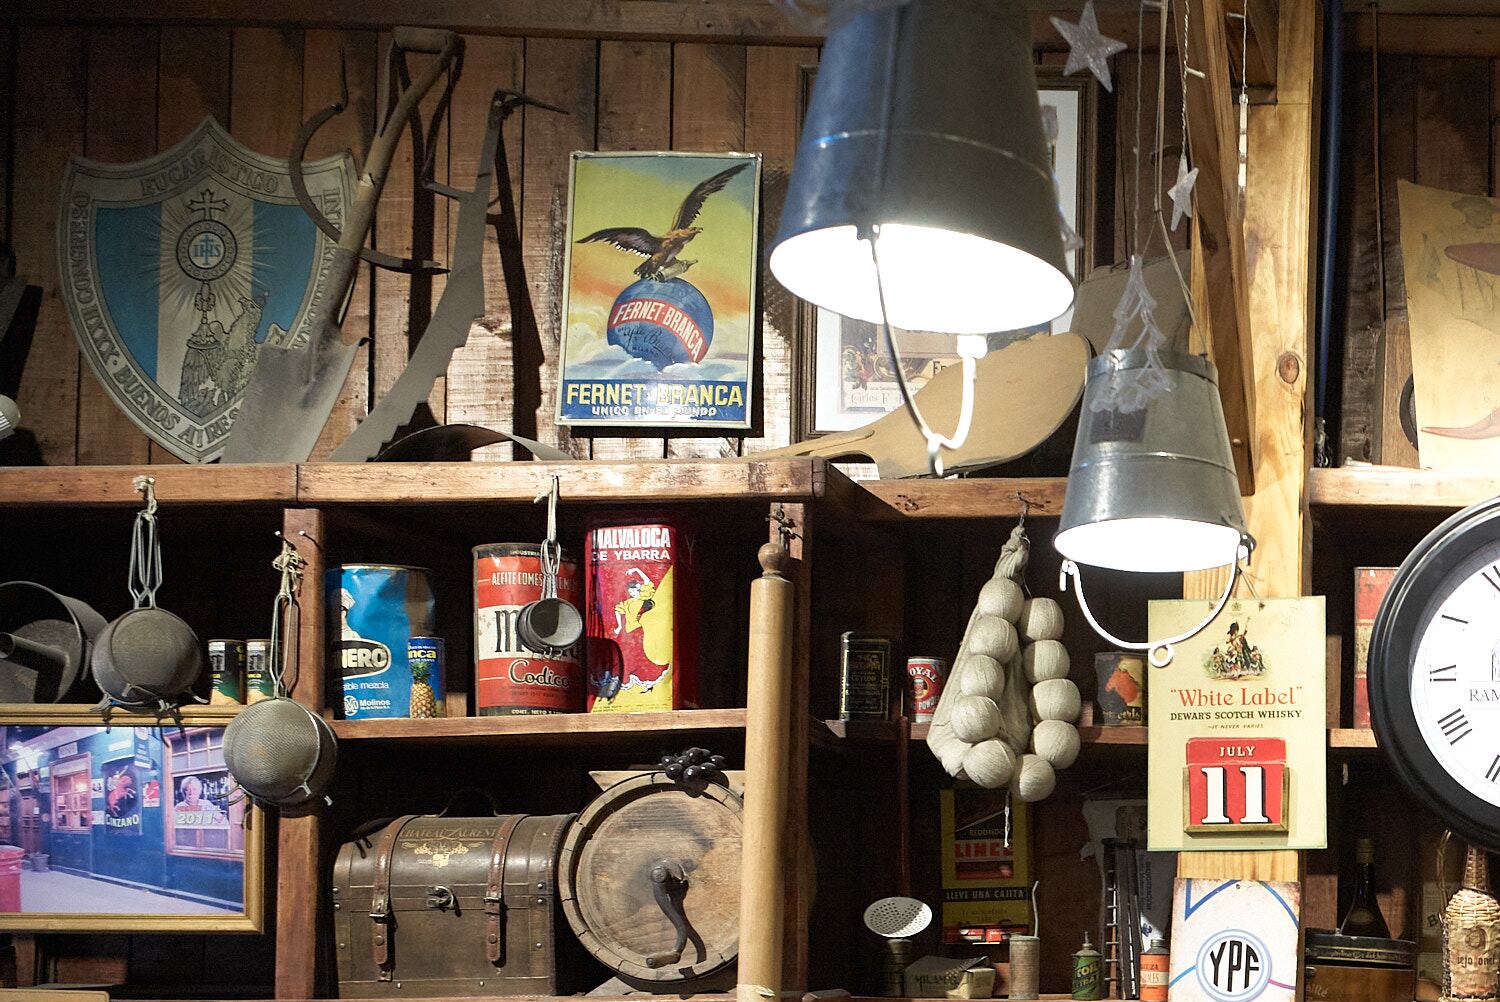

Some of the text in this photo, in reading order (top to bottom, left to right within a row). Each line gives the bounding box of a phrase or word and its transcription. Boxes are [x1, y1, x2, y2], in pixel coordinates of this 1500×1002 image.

[612, 300, 703, 361] FERNET-BRANCA
[113, 367, 181, 431] BUENOS
[614, 550, 671, 561] YBARRA
[360, 681, 390, 690] mezcla
[359, 699, 392, 707] Molinos
[1214, 710, 1254, 720] SCOTCH
[1257, 709, 1303, 719] WHISKY
[1219, 746, 1256, 758] JULY
[1201, 766, 1273, 825] 11
[972, 890, 990, 899] UNA
[993, 889, 1024, 899] CAJITA
[1209, 940, 1260, 992] YPF
